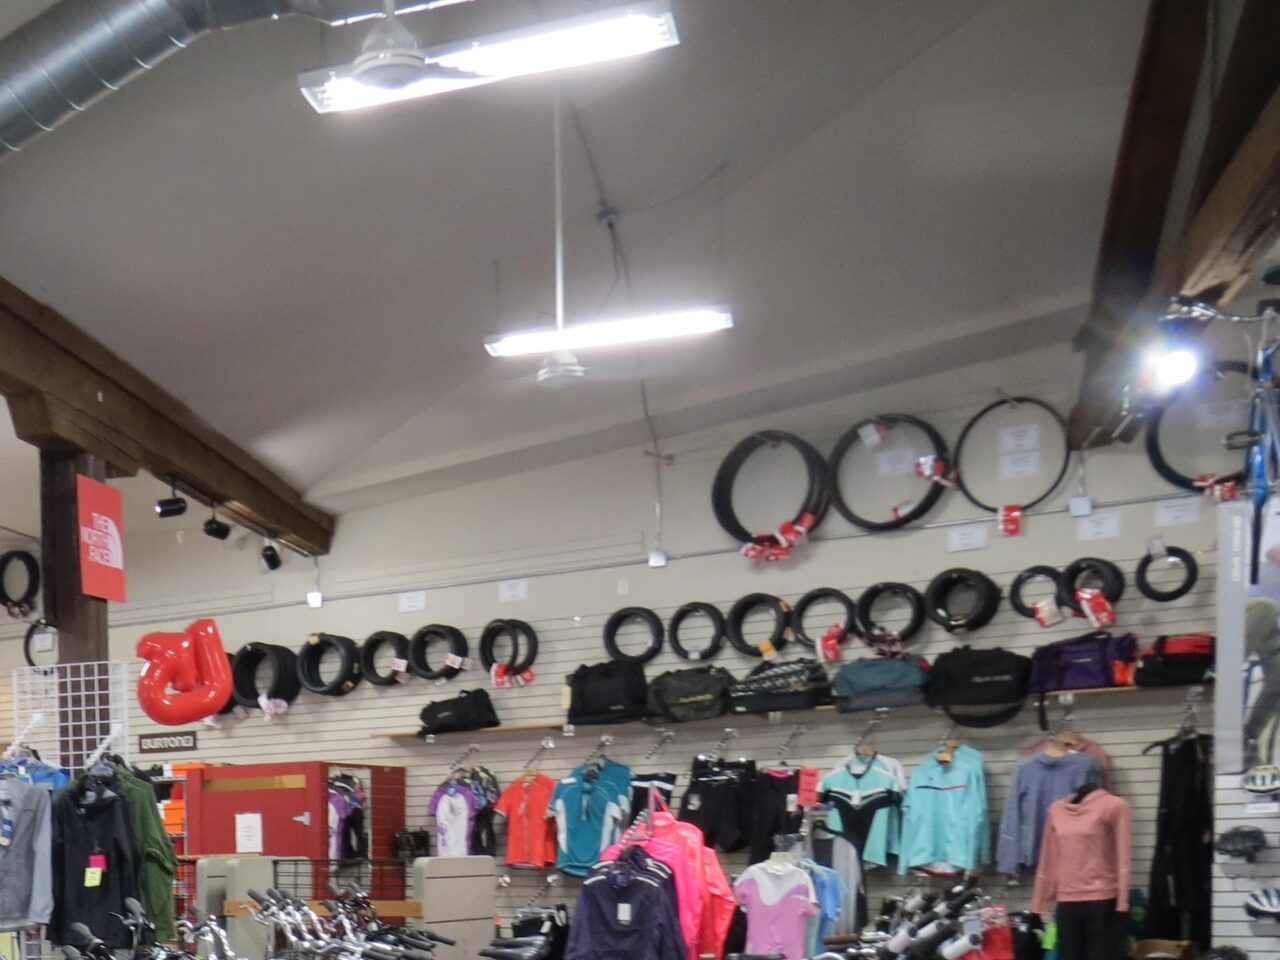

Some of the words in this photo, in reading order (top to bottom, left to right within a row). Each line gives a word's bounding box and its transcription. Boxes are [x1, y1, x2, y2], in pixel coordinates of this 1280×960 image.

[91, 512, 108, 532] THE
[80, 525, 109, 549] NORTH
[88, 545, 111, 565] FACE
